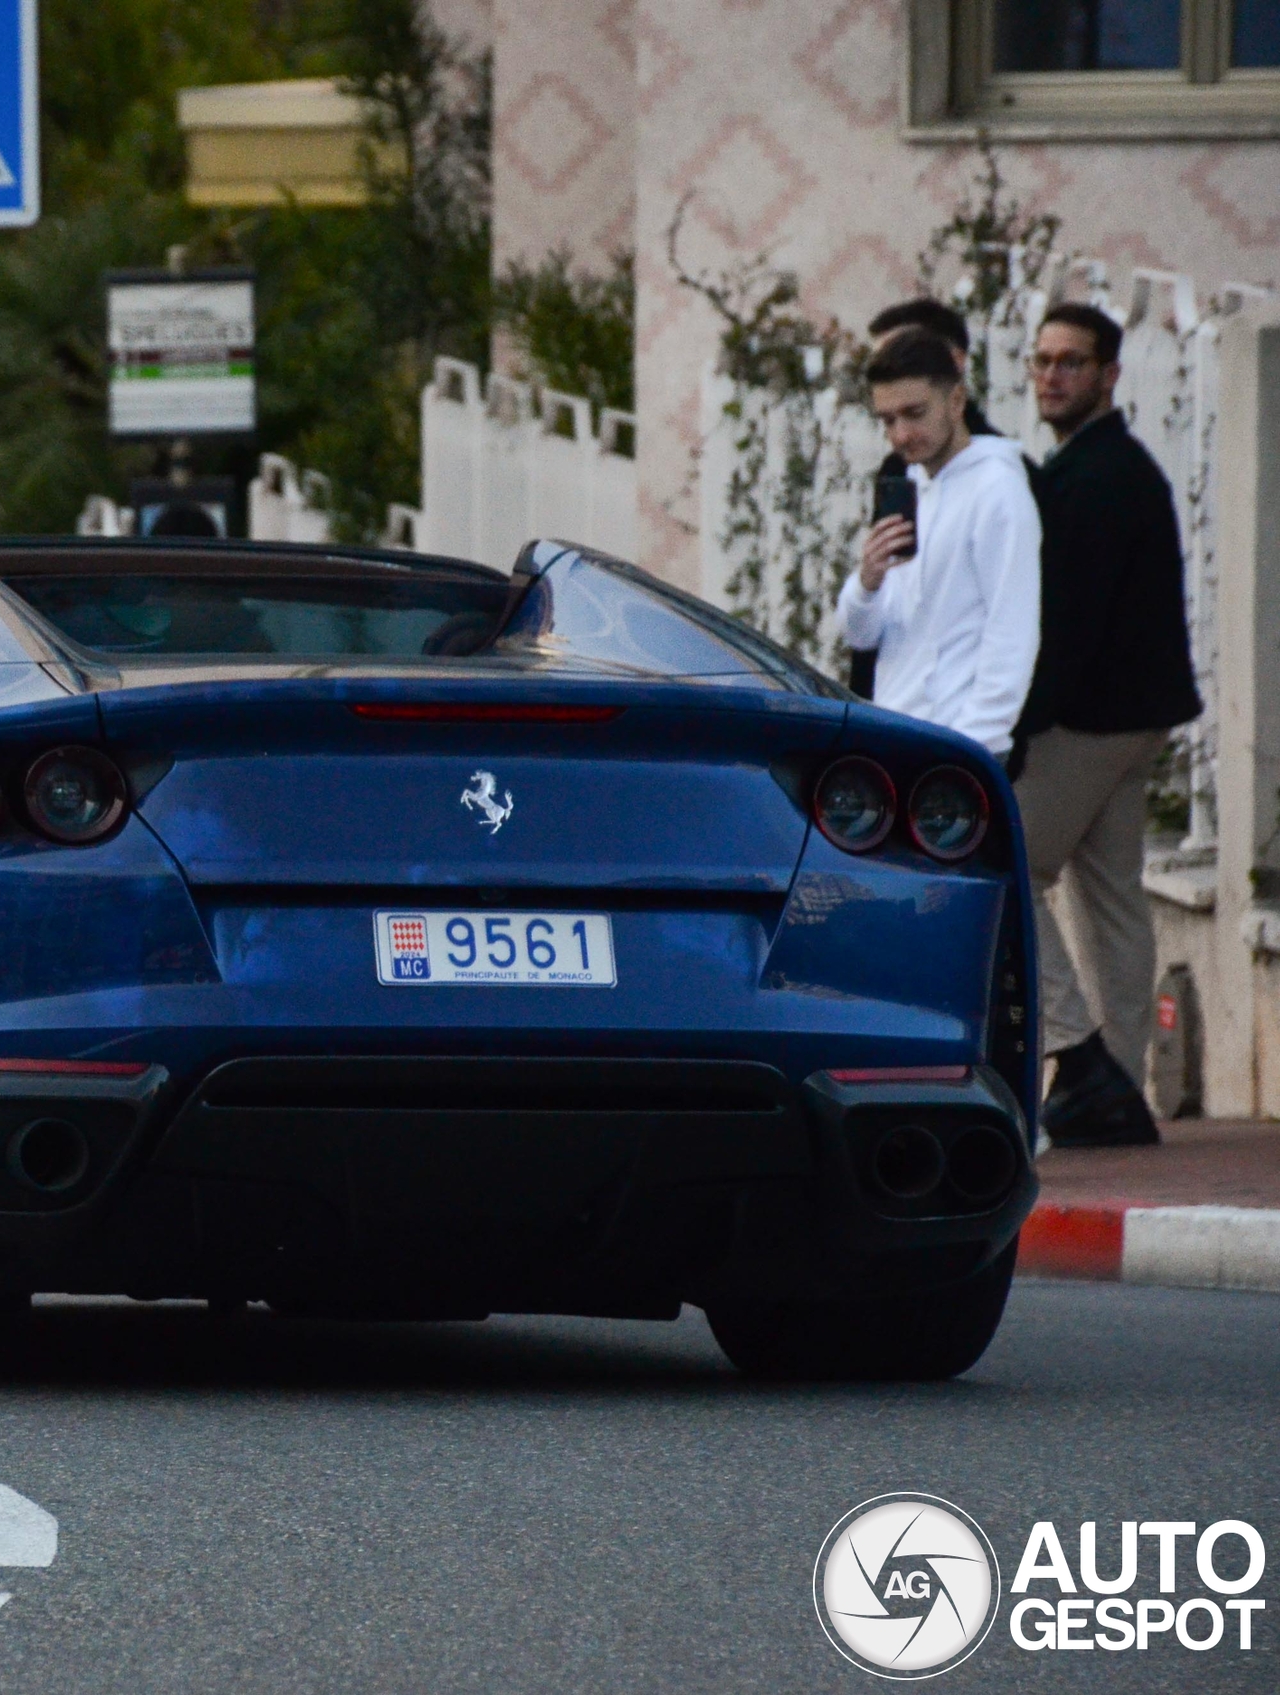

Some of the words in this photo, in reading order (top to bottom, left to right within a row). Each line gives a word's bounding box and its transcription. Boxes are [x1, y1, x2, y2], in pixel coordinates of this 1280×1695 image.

[445, 917, 589, 970] 9561
[400, 960, 423, 976] MC
[527, 971, 540, 980] DE
[548, 972, 593, 981] MONACO
